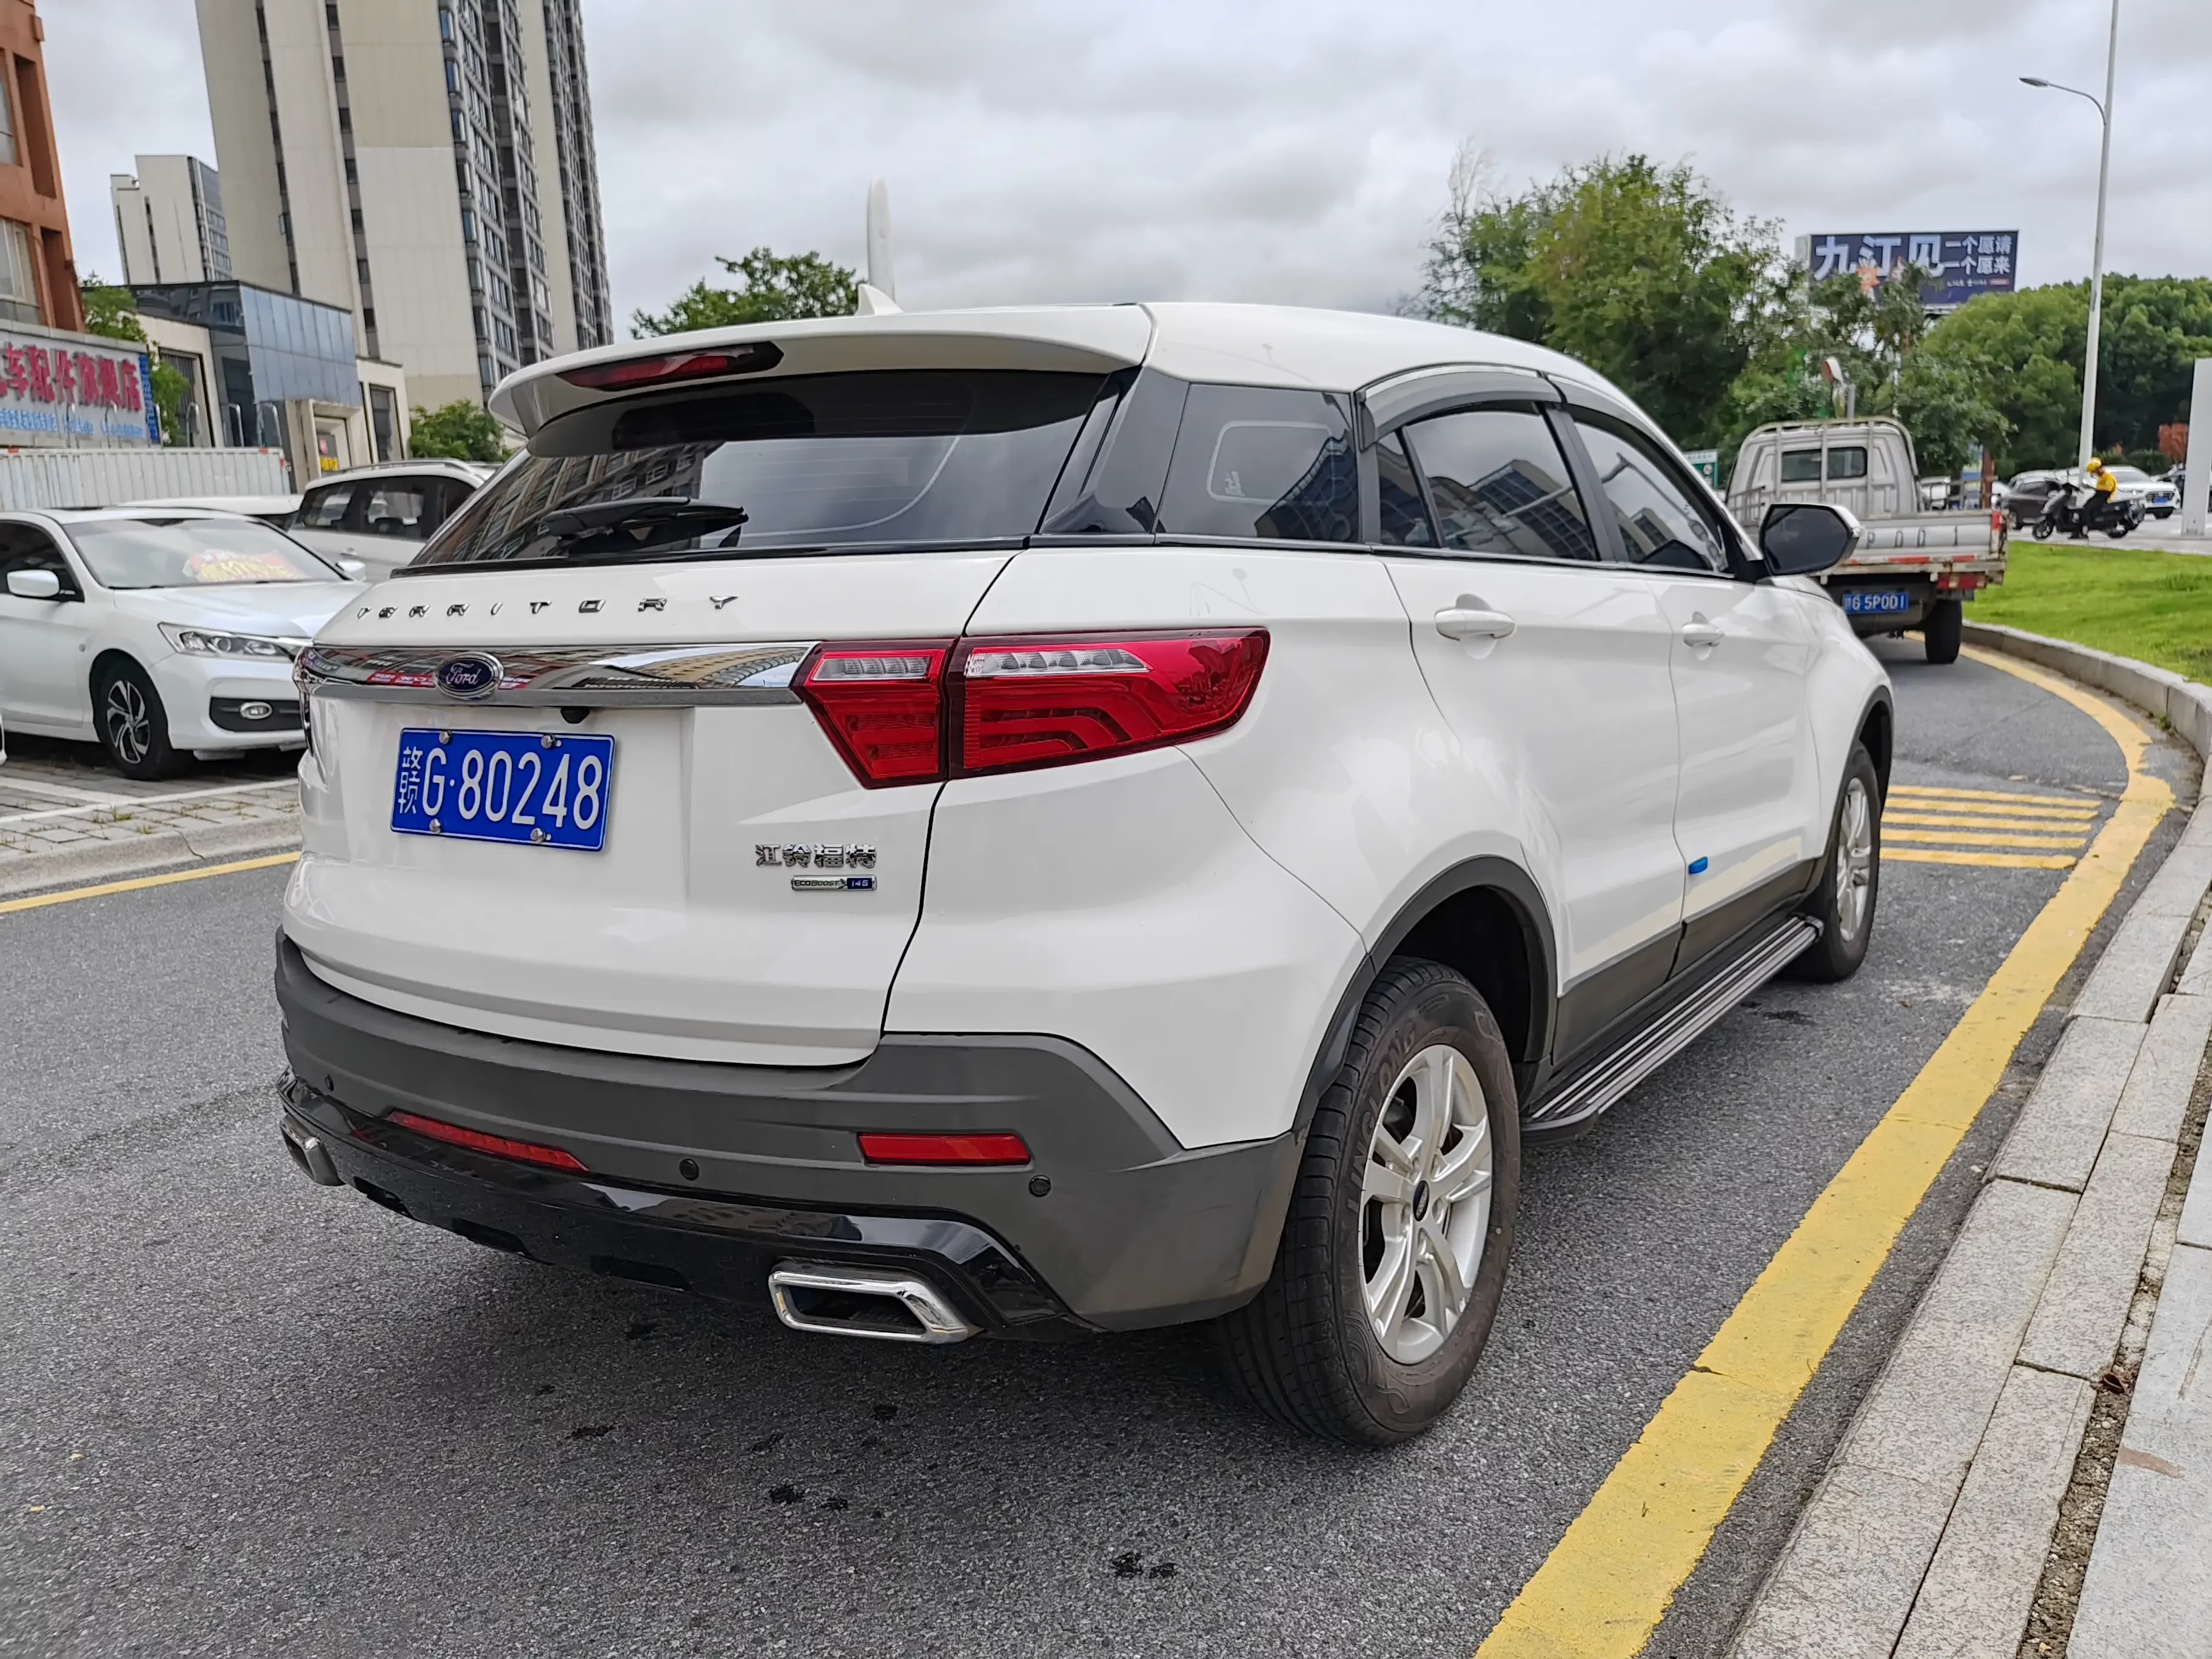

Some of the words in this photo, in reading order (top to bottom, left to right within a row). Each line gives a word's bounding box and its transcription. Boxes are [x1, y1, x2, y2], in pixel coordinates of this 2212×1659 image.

[0, 341, 142, 411] 车配件旗舰店
[357, 595, 738, 619] TERRITORY
[446, 662, 481, 686] Ford
[755, 843, 877, 868] 江铃福特
